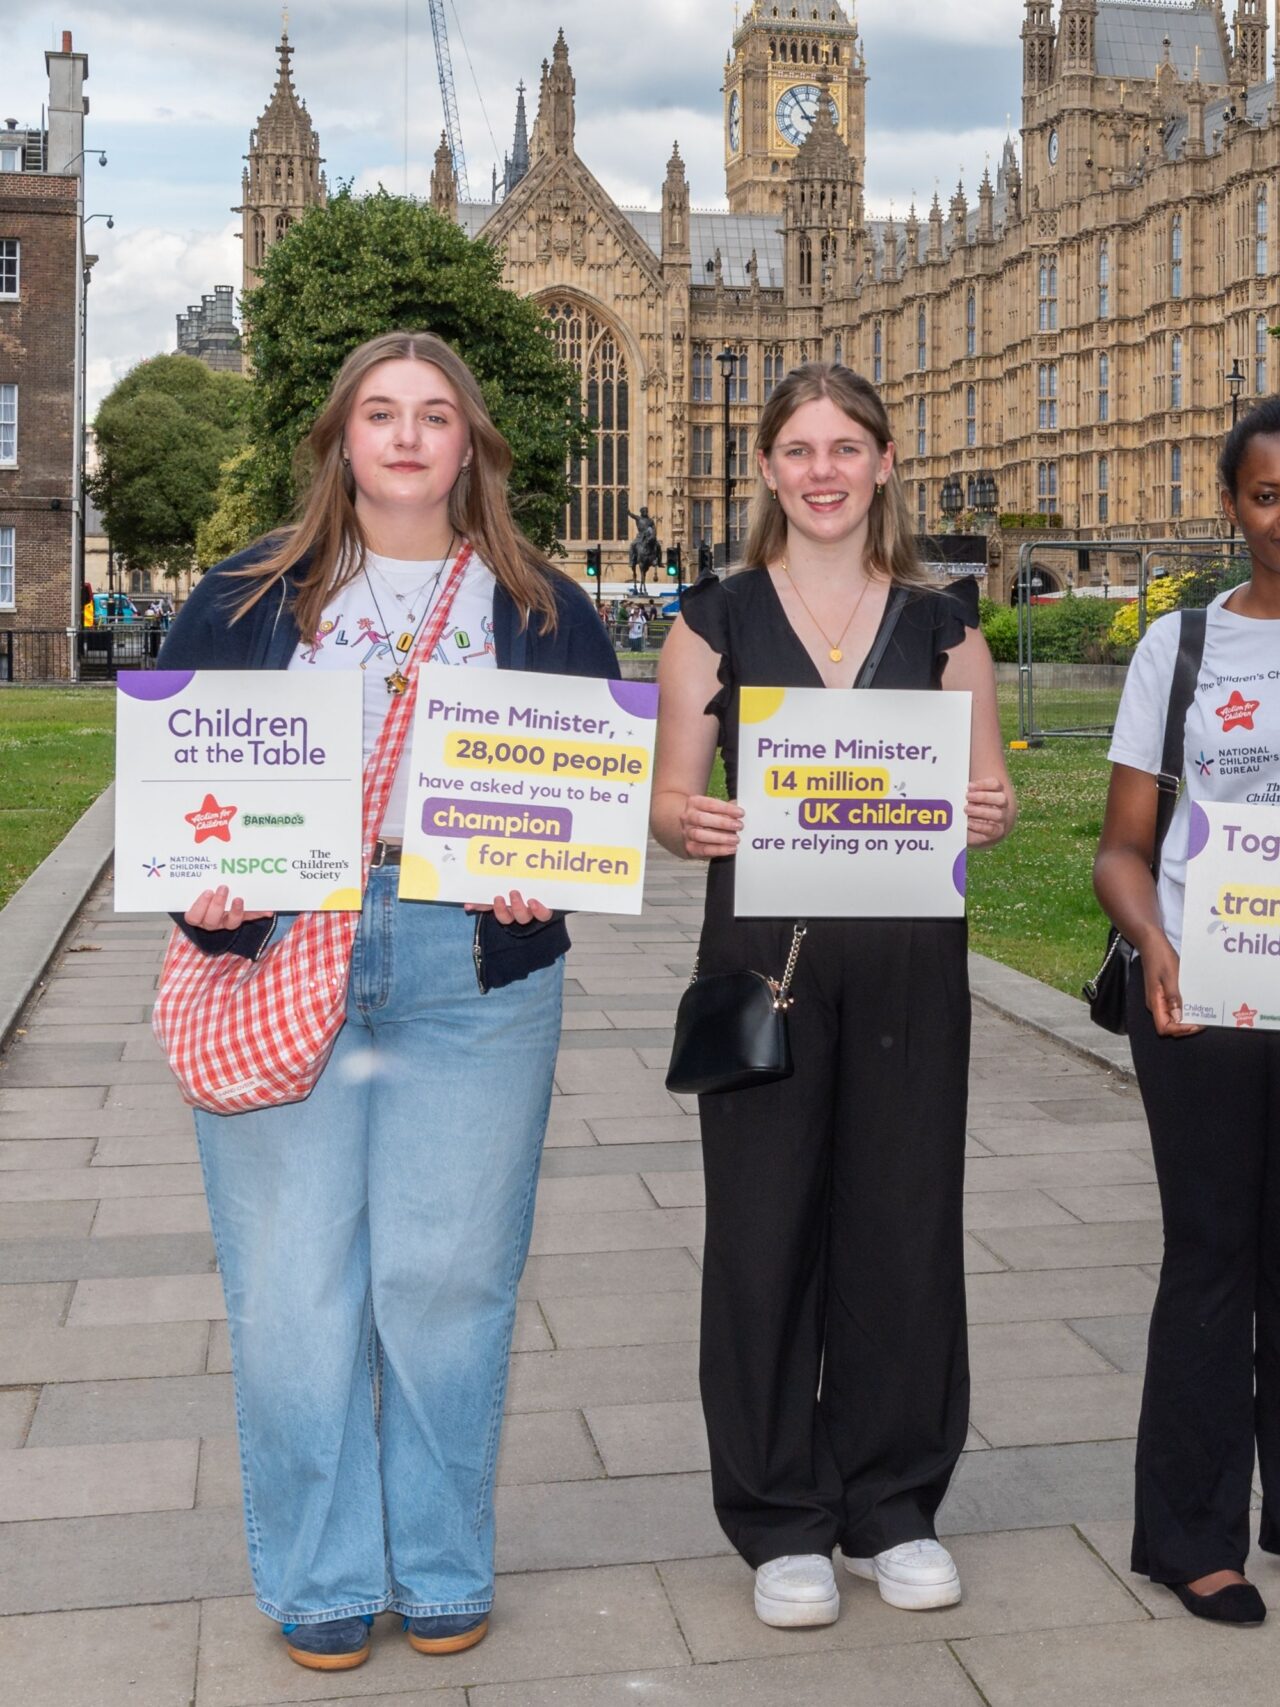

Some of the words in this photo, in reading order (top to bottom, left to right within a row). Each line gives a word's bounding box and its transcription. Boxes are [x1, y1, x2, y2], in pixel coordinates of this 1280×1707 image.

[1220, 704, 1244, 716] Action
[1244, 703, 1255, 711] for
[1223, 711, 1252, 722] Children
[168, 708, 308, 738] Children
[427, 699, 500, 725] Prime
[508, 706, 616, 739] Minister,
[174, 745, 198, 764] at
[206, 743, 244, 764] the
[247, 740, 326, 766] Table
[456, 739, 545, 766] 28,000
[552, 752, 643, 776] people
[757, 738, 826, 759] Prime
[834, 739, 938, 764] Minister,
[1218, 746, 1270, 757] NATIONAL
[1219, 755, 1280, 766] CHILDREN'S
[1219, 765, 1260, 775] BUREAU
[418, 772, 464, 791] have
[470, 777, 524, 796] asked
[529, 783, 561, 800] you
[567, 786, 585, 801] to
[590, 786, 612, 803] be
[617, 792, 629, 804] a
[771, 770, 798, 791] 14
[806, 770, 885, 792] million
[432, 805, 561, 837] champion
[803, 803, 840, 824] UK
[848, 803, 947, 825] children
[195, 817, 228, 831] Children
[751, 837, 786, 851] are
[791, 834, 859, 855] relying
[864, 838, 888, 852] on
[894, 838, 935, 855] you.
[309, 849, 331, 859] The
[479, 843, 517, 867] for
[525, 848, 629, 876] children
[220, 858, 288, 875] NSPCC
[291, 859, 350, 870] Children's
[170, 870, 203, 878] BUREAU
[299, 870, 342, 882] Society
[1184, 1003, 1214, 1013] Children
